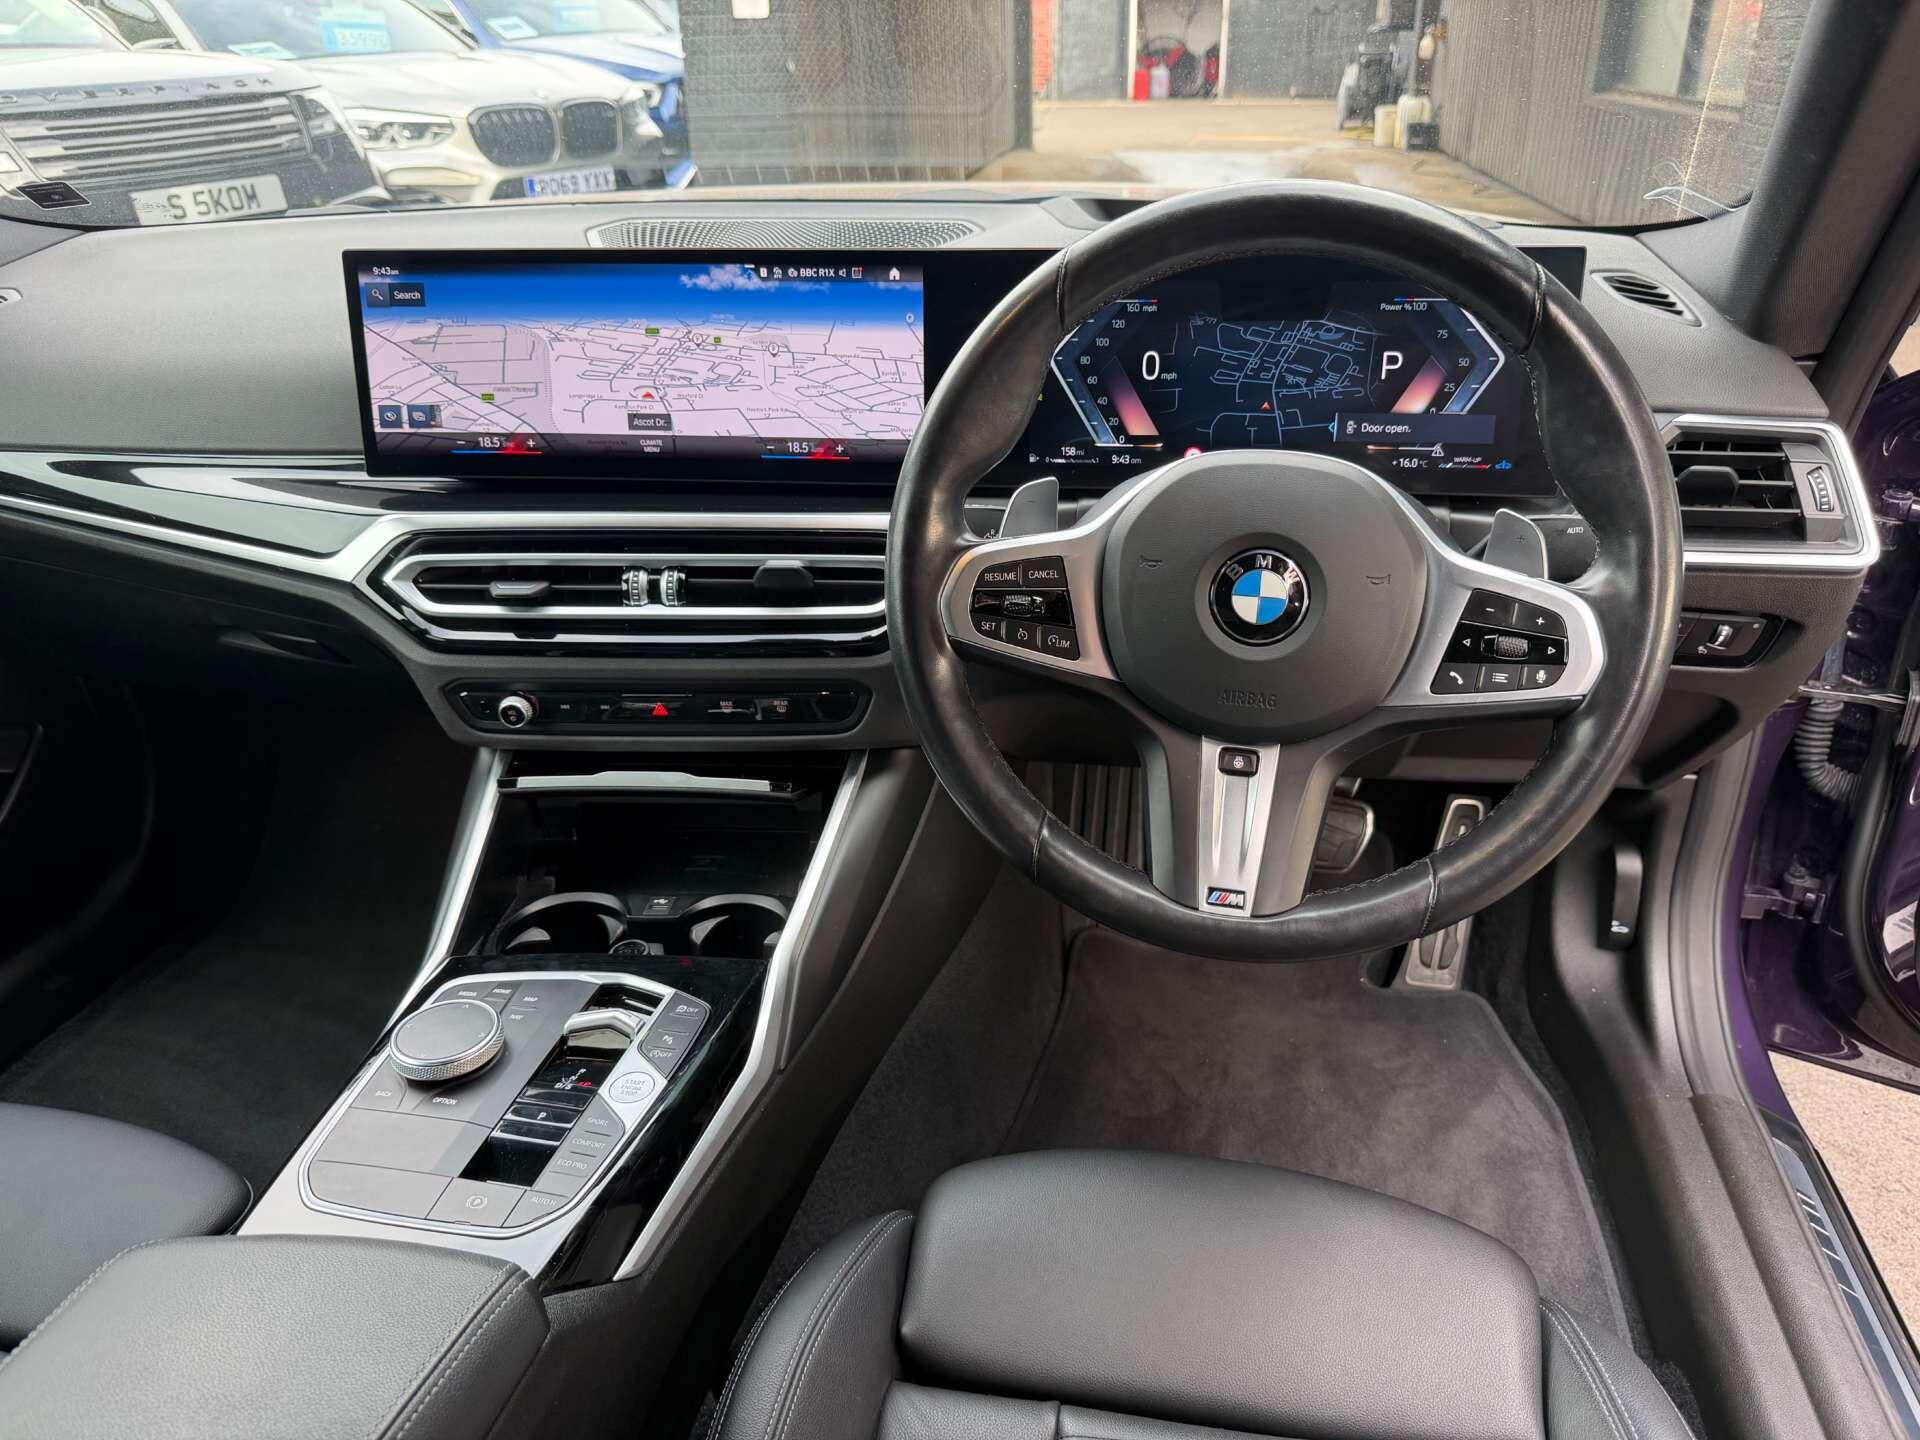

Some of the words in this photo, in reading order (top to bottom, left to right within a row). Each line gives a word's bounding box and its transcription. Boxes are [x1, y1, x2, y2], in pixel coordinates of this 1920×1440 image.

[800, 267, 817, 278] BBC
[819, 267, 835, 278] R1X
[394, 290, 421, 300] Search
[1126, 303, 1140, 313] 160
[1142, 304, 1158, 313] mph
[1380, 303, 1403, 312] Power
[1111, 319, 1126, 329] 120
[1436, 329, 1449, 339] 75
[1095, 337, 1110, 347] 100
[1080, 355, 1091, 365] 80
[1458, 358, 1470, 367] 50
[1141, 350, 1161, 381] 0
[1161, 372, 1178, 380] mph
[1380, 351, 1404, 381] P
[1087, 375, 1098, 385] 60
[1444, 383, 1456, 392] 25
[1097, 396, 1108, 405] 40
[633, 418, 654, 426] Ascot
[655, 418, 667, 426] Dr.
[1109, 417, 1119, 426] 20
[1361, 423, 1384, 433] Door
[1385, 424, 1411, 435] open.
[478, 437, 500, 448] 18.5
[1119, 435, 1125, 444] 0
[787, 441, 809, 453] 18.5
[1061, 446, 1076, 457] 158
[1111, 455, 1130, 464] 9:43
[1566, 526, 1584, 534] AUTO
[1225, 554, 1301, 586] BMW
[984, 571, 1017, 582] RESUME
[1028, 569, 1060, 580] CANCEL
[980, 621, 996, 631] SET
[1056, 638, 1071, 649] LIM
[1217, 689, 1278, 710] AIRBAG
[432, 1096, 458, 1105] OPTION
[537, 1111, 547, 1120] P
